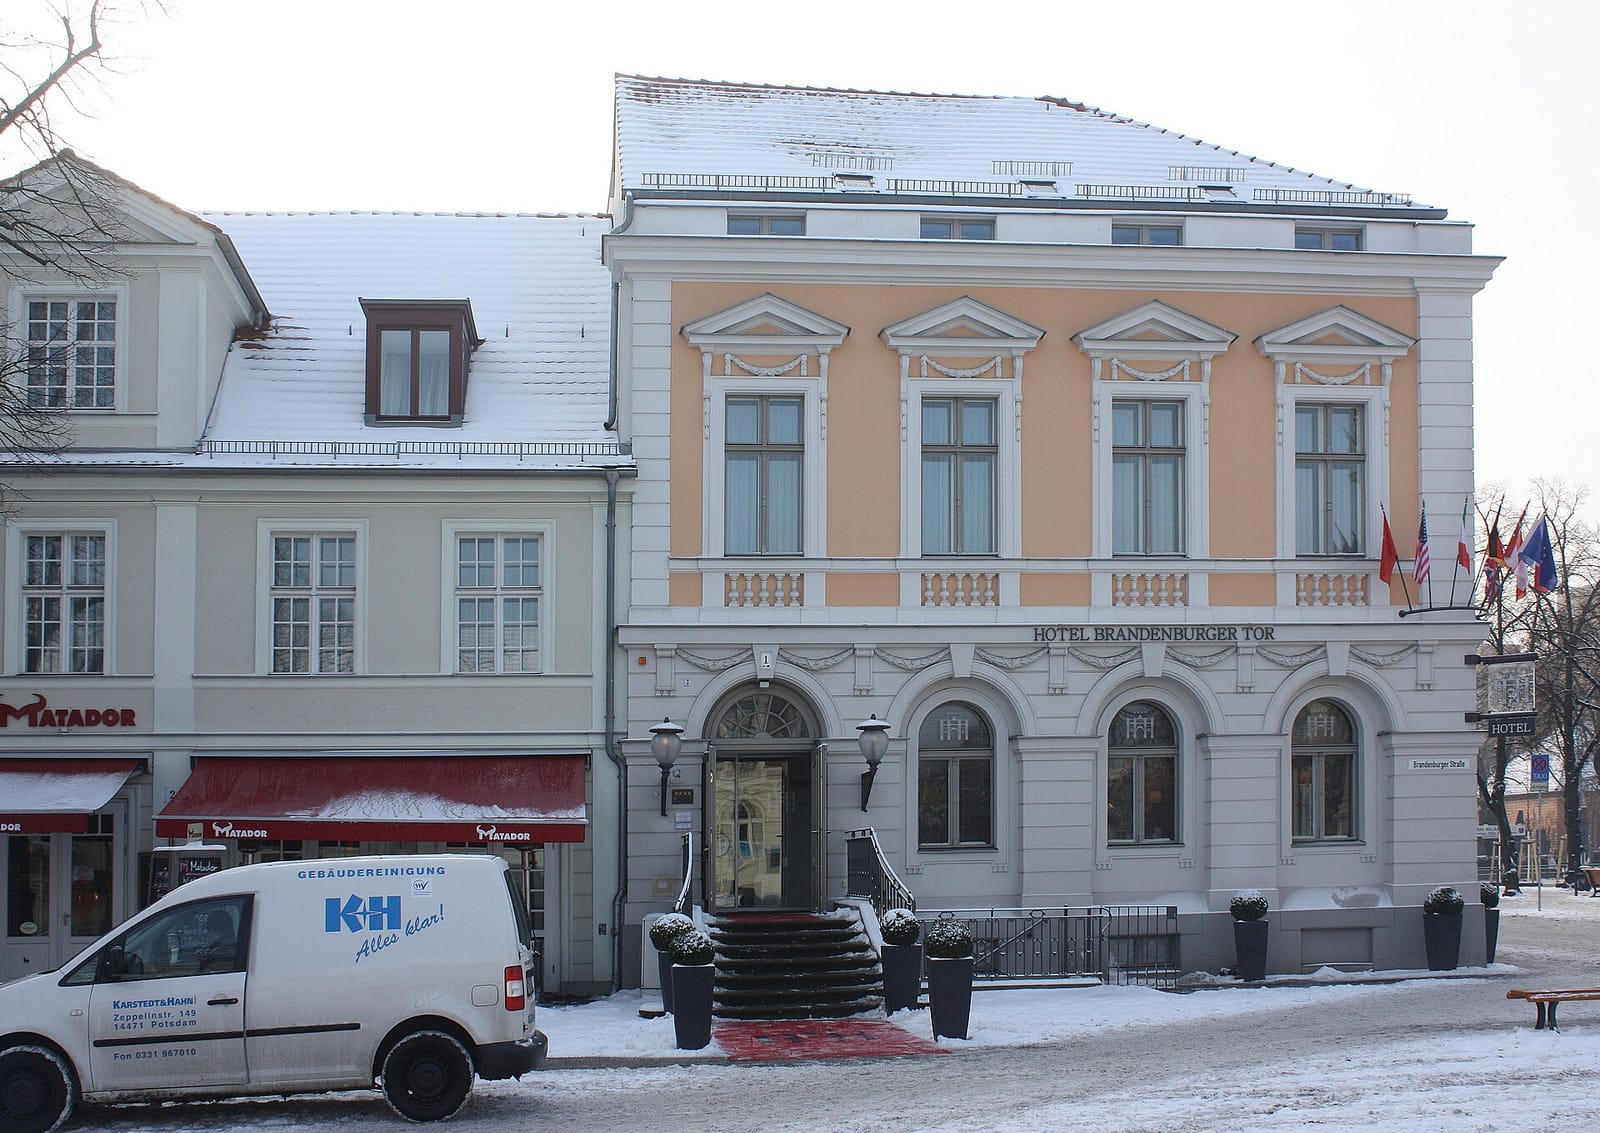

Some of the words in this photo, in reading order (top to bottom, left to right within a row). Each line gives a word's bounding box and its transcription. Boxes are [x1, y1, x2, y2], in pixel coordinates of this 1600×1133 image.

[1033, 627, 1090, 642] HOTEL
[1094, 627, 1238, 642] BRANDENBURGER
[1242, 627, 1276, 641] TOR
[0, 693, 136, 728] MATADOR
[1492, 722, 1532, 735] HOTEL
[1413, 760, 1449, 770] Brandenburger
[1450, 760, 1465, 768] Straße
[1533, 772, 1548, 780] TAXI
[212, 821, 268, 838] MATADOR
[476, 824, 531, 840] MATADOR
[297, 866, 446, 879] GEBÄUDEREINIGUNG
[355, 933, 400, 963] Alles
[405, 903, 444, 937] klar!
[113, 997, 193, 1009] KARSTEDT&HAHN
[113, 1012, 174, 1022] Zeppelinstr.
[180, 1009, 197, 1017] 149
[114, 1022, 143, 1030] 14471
[151, 1020, 196, 1028] Potsdam
[135, 1051, 157, 1059] 0331
[162, 1048, 196, 1057] 967010
